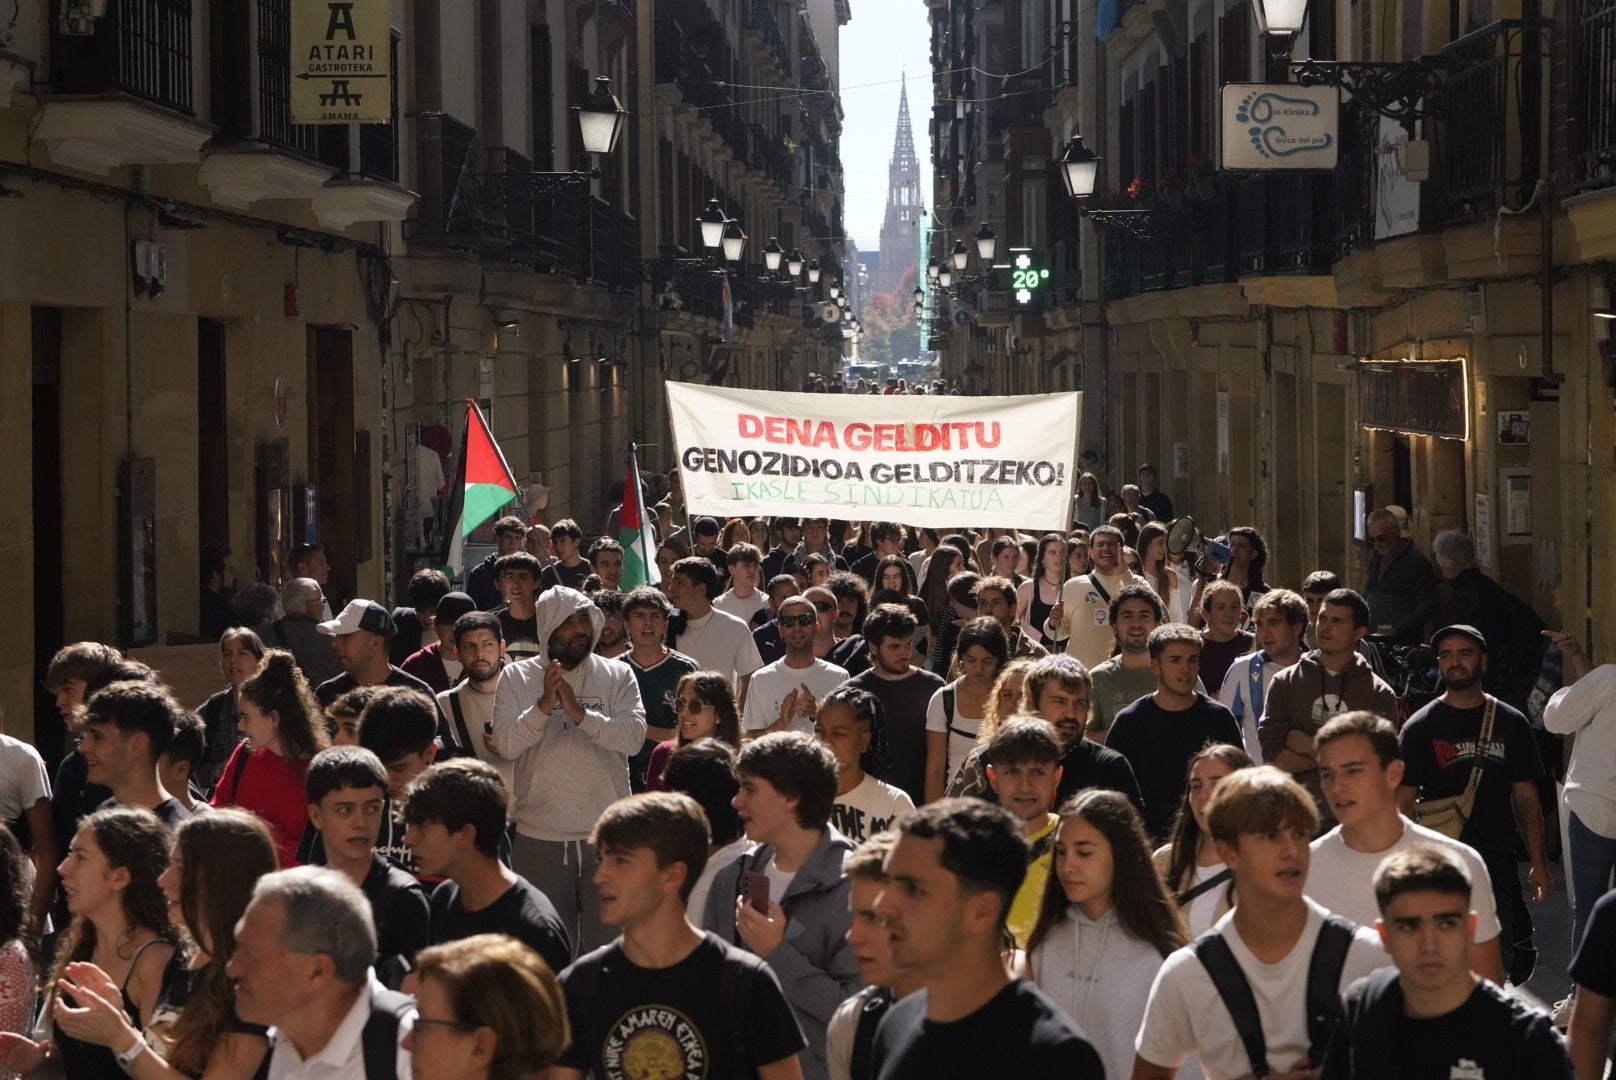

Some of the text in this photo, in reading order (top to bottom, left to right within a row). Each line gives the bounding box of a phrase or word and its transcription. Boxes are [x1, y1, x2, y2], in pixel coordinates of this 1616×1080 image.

[309, 45, 374, 60] ATARI
[309, 63, 373, 72] GASTROTEKA
[322, 112, 359, 120] AMAMA
[1298, 136, 1310, 144] del
[737, 413, 1001, 452] DENA GELDITU
[682, 446, 864, 482] GENOZIDIOA
[731, 479, 1004, 510] IKASLE SINDIKATUA
[605, 1009, 703, 1070] NIRE AMAREN ETXEA
